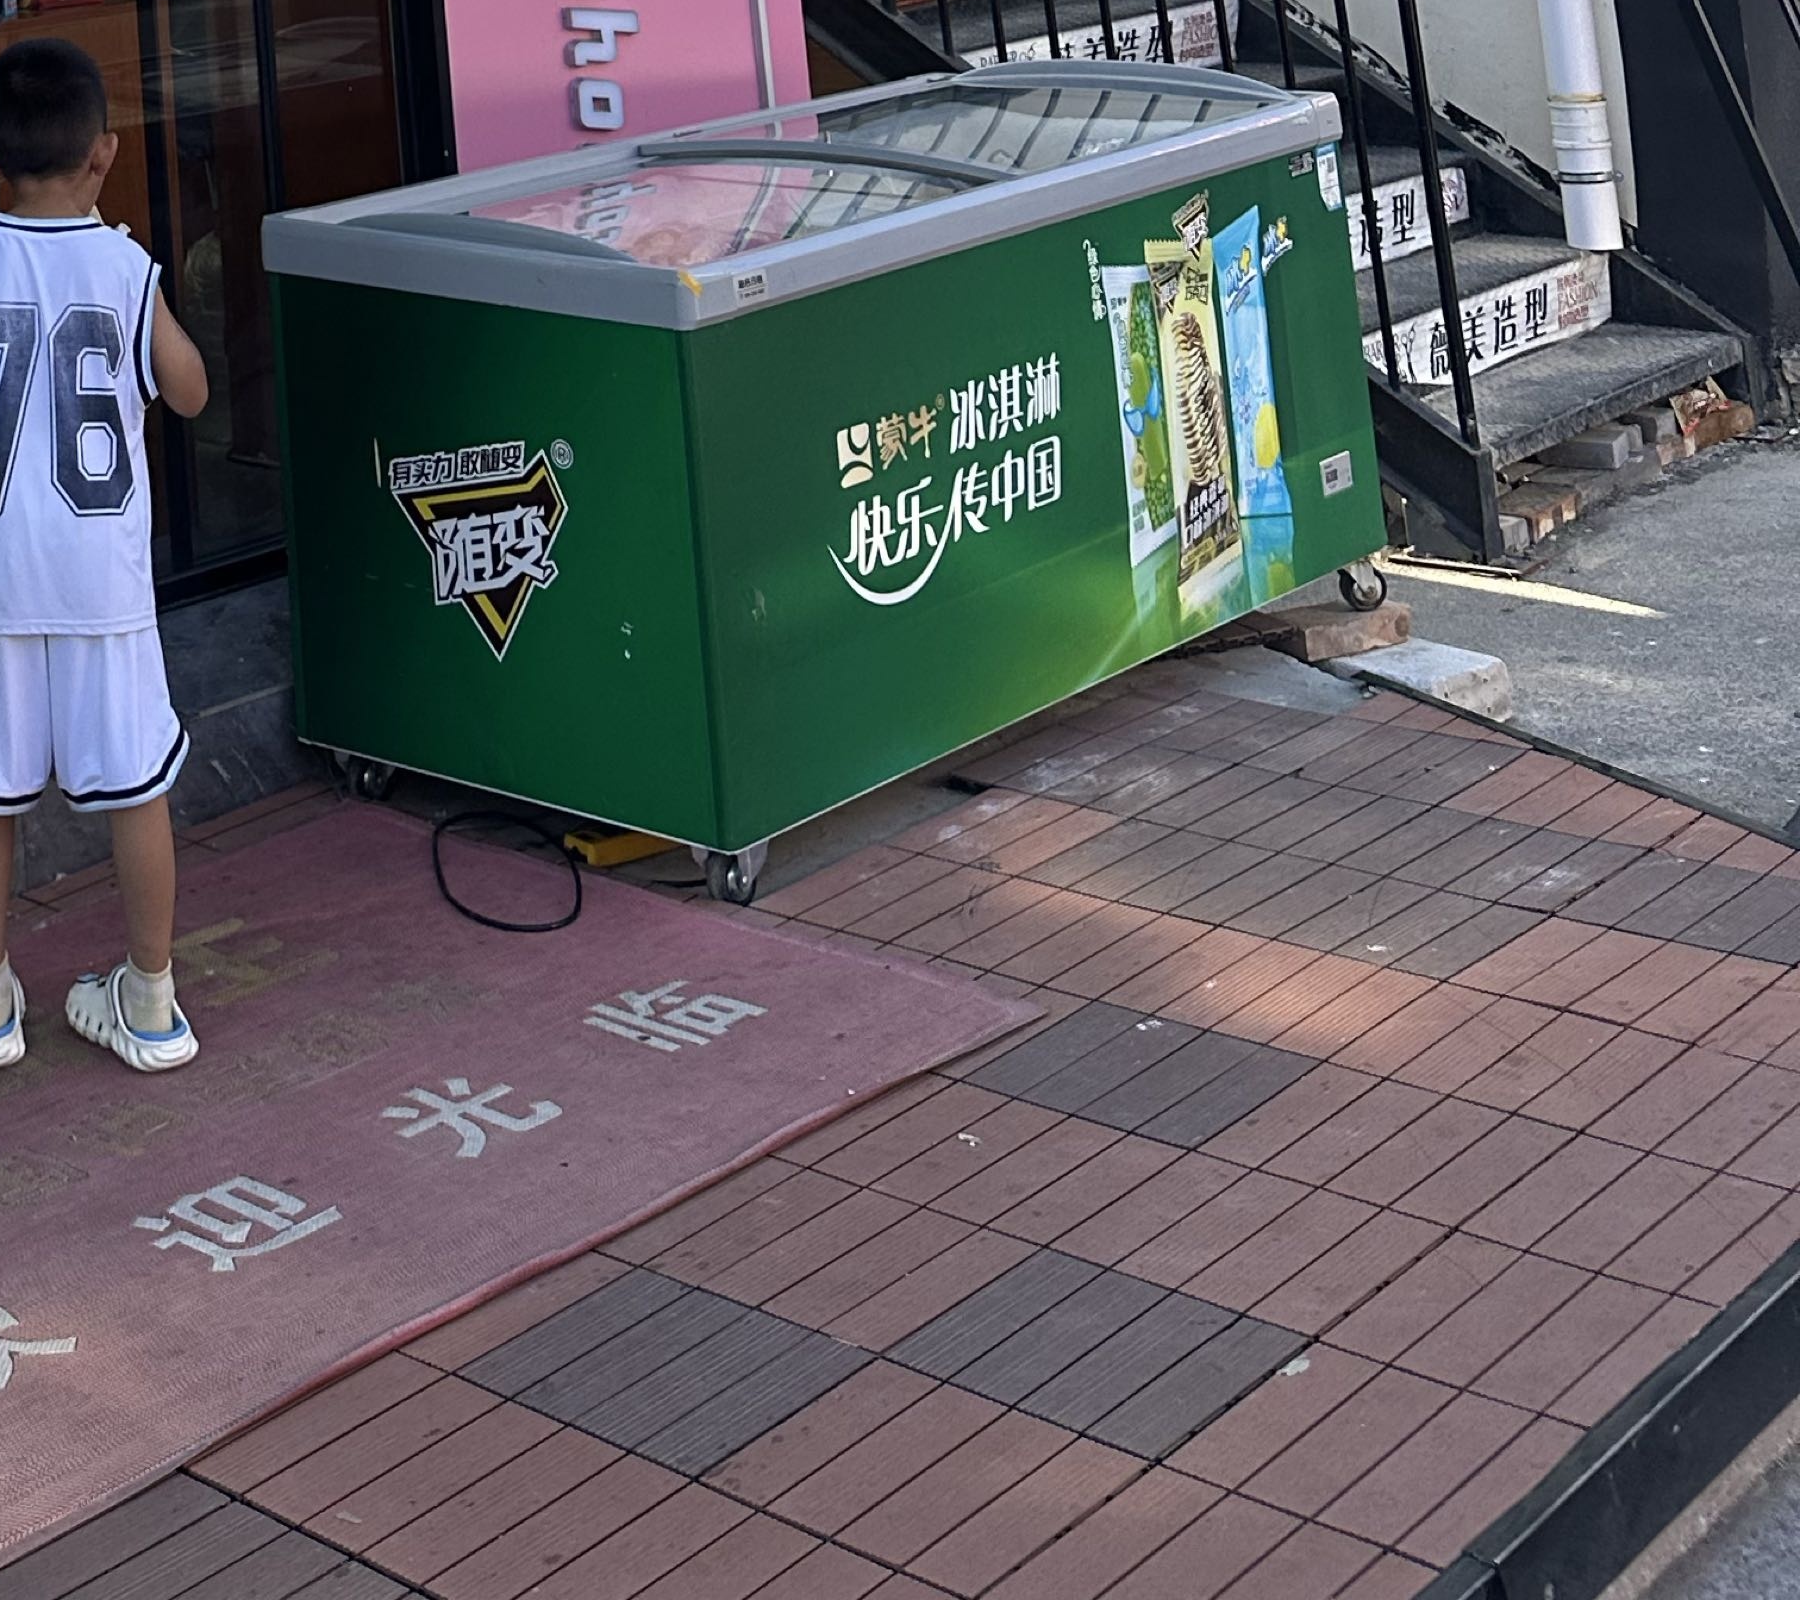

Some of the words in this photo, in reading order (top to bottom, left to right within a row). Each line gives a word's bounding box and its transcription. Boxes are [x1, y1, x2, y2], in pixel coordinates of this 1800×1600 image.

[875, 404, 938, 471] 蒙牛
[949, 351, 1062, 455] 冰淇淋
[428, 503, 551, 598] 随变
[842, 435, 1062, 577] 快乐传中国
